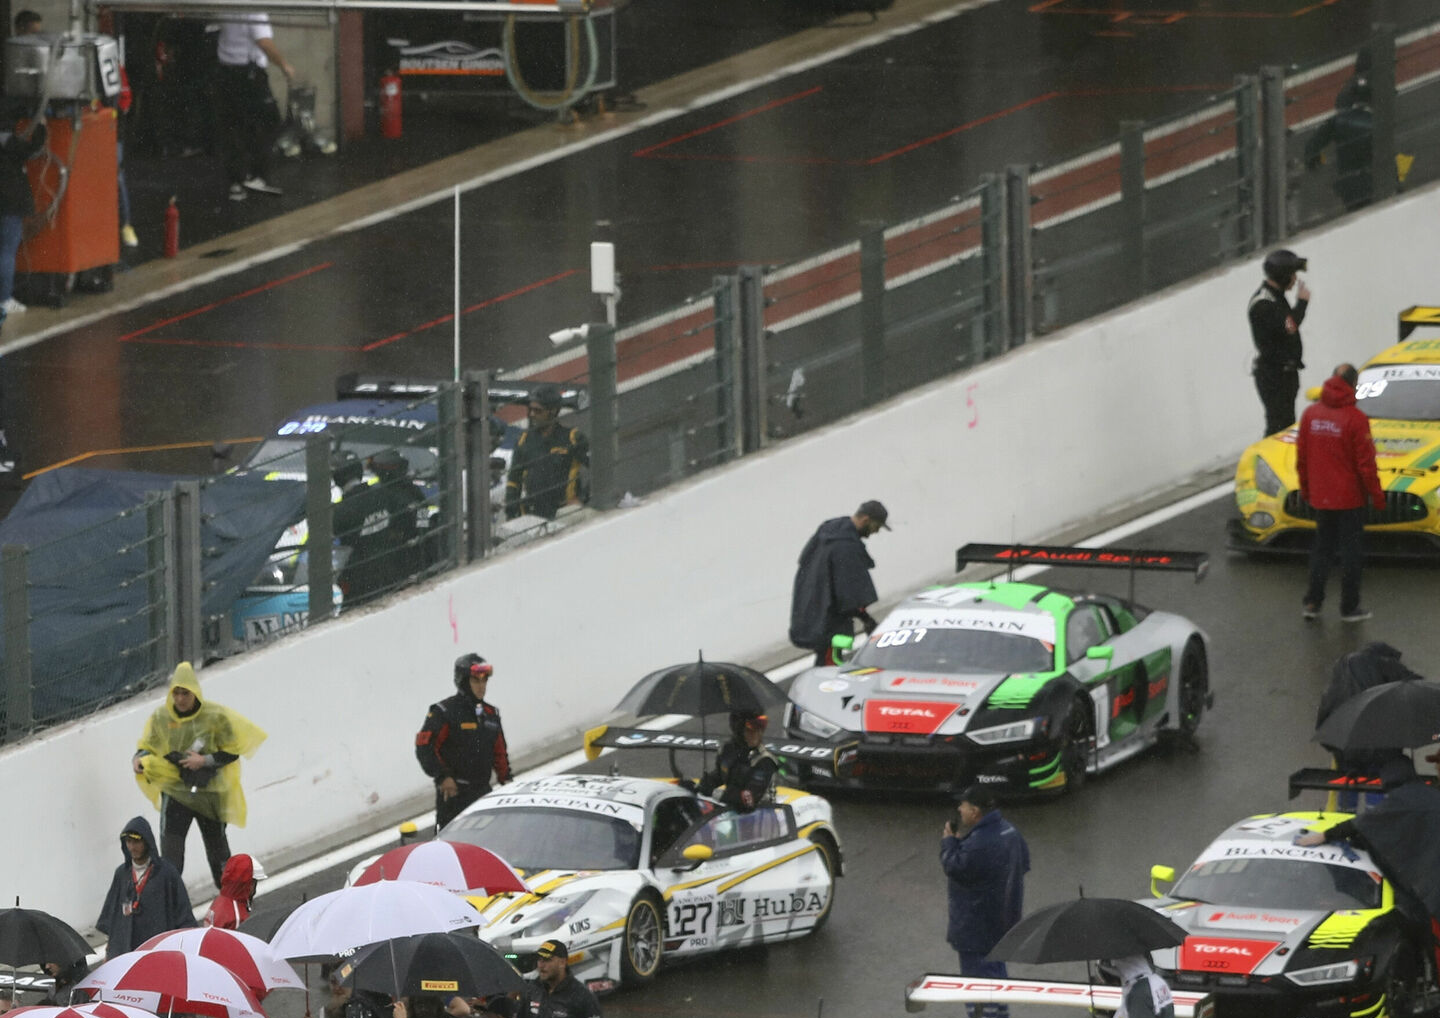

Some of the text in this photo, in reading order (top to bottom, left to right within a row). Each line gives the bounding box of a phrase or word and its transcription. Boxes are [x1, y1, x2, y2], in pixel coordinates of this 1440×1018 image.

[1032, 550, 1092, 561] Audi
[899, 618, 1026, 632] BLANCPAIN
[878, 706, 936, 718] TOTAL
[976, 774, 1009, 783] TOTAL
[496, 797, 622, 815] BLANCPAIN
[1224, 847, 1358, 864] BLANCPAIN
[1227, 912, 1300, 926] Audi Sport
[569, 918, 591, 935] KIKS
[689, 938, 708, 947] PRO
[1193, 943, 1252, 956] TOTAL
[203, 992, 232, 1003] TOTAL
[921, 980, 1202, 1006] PORSCE
